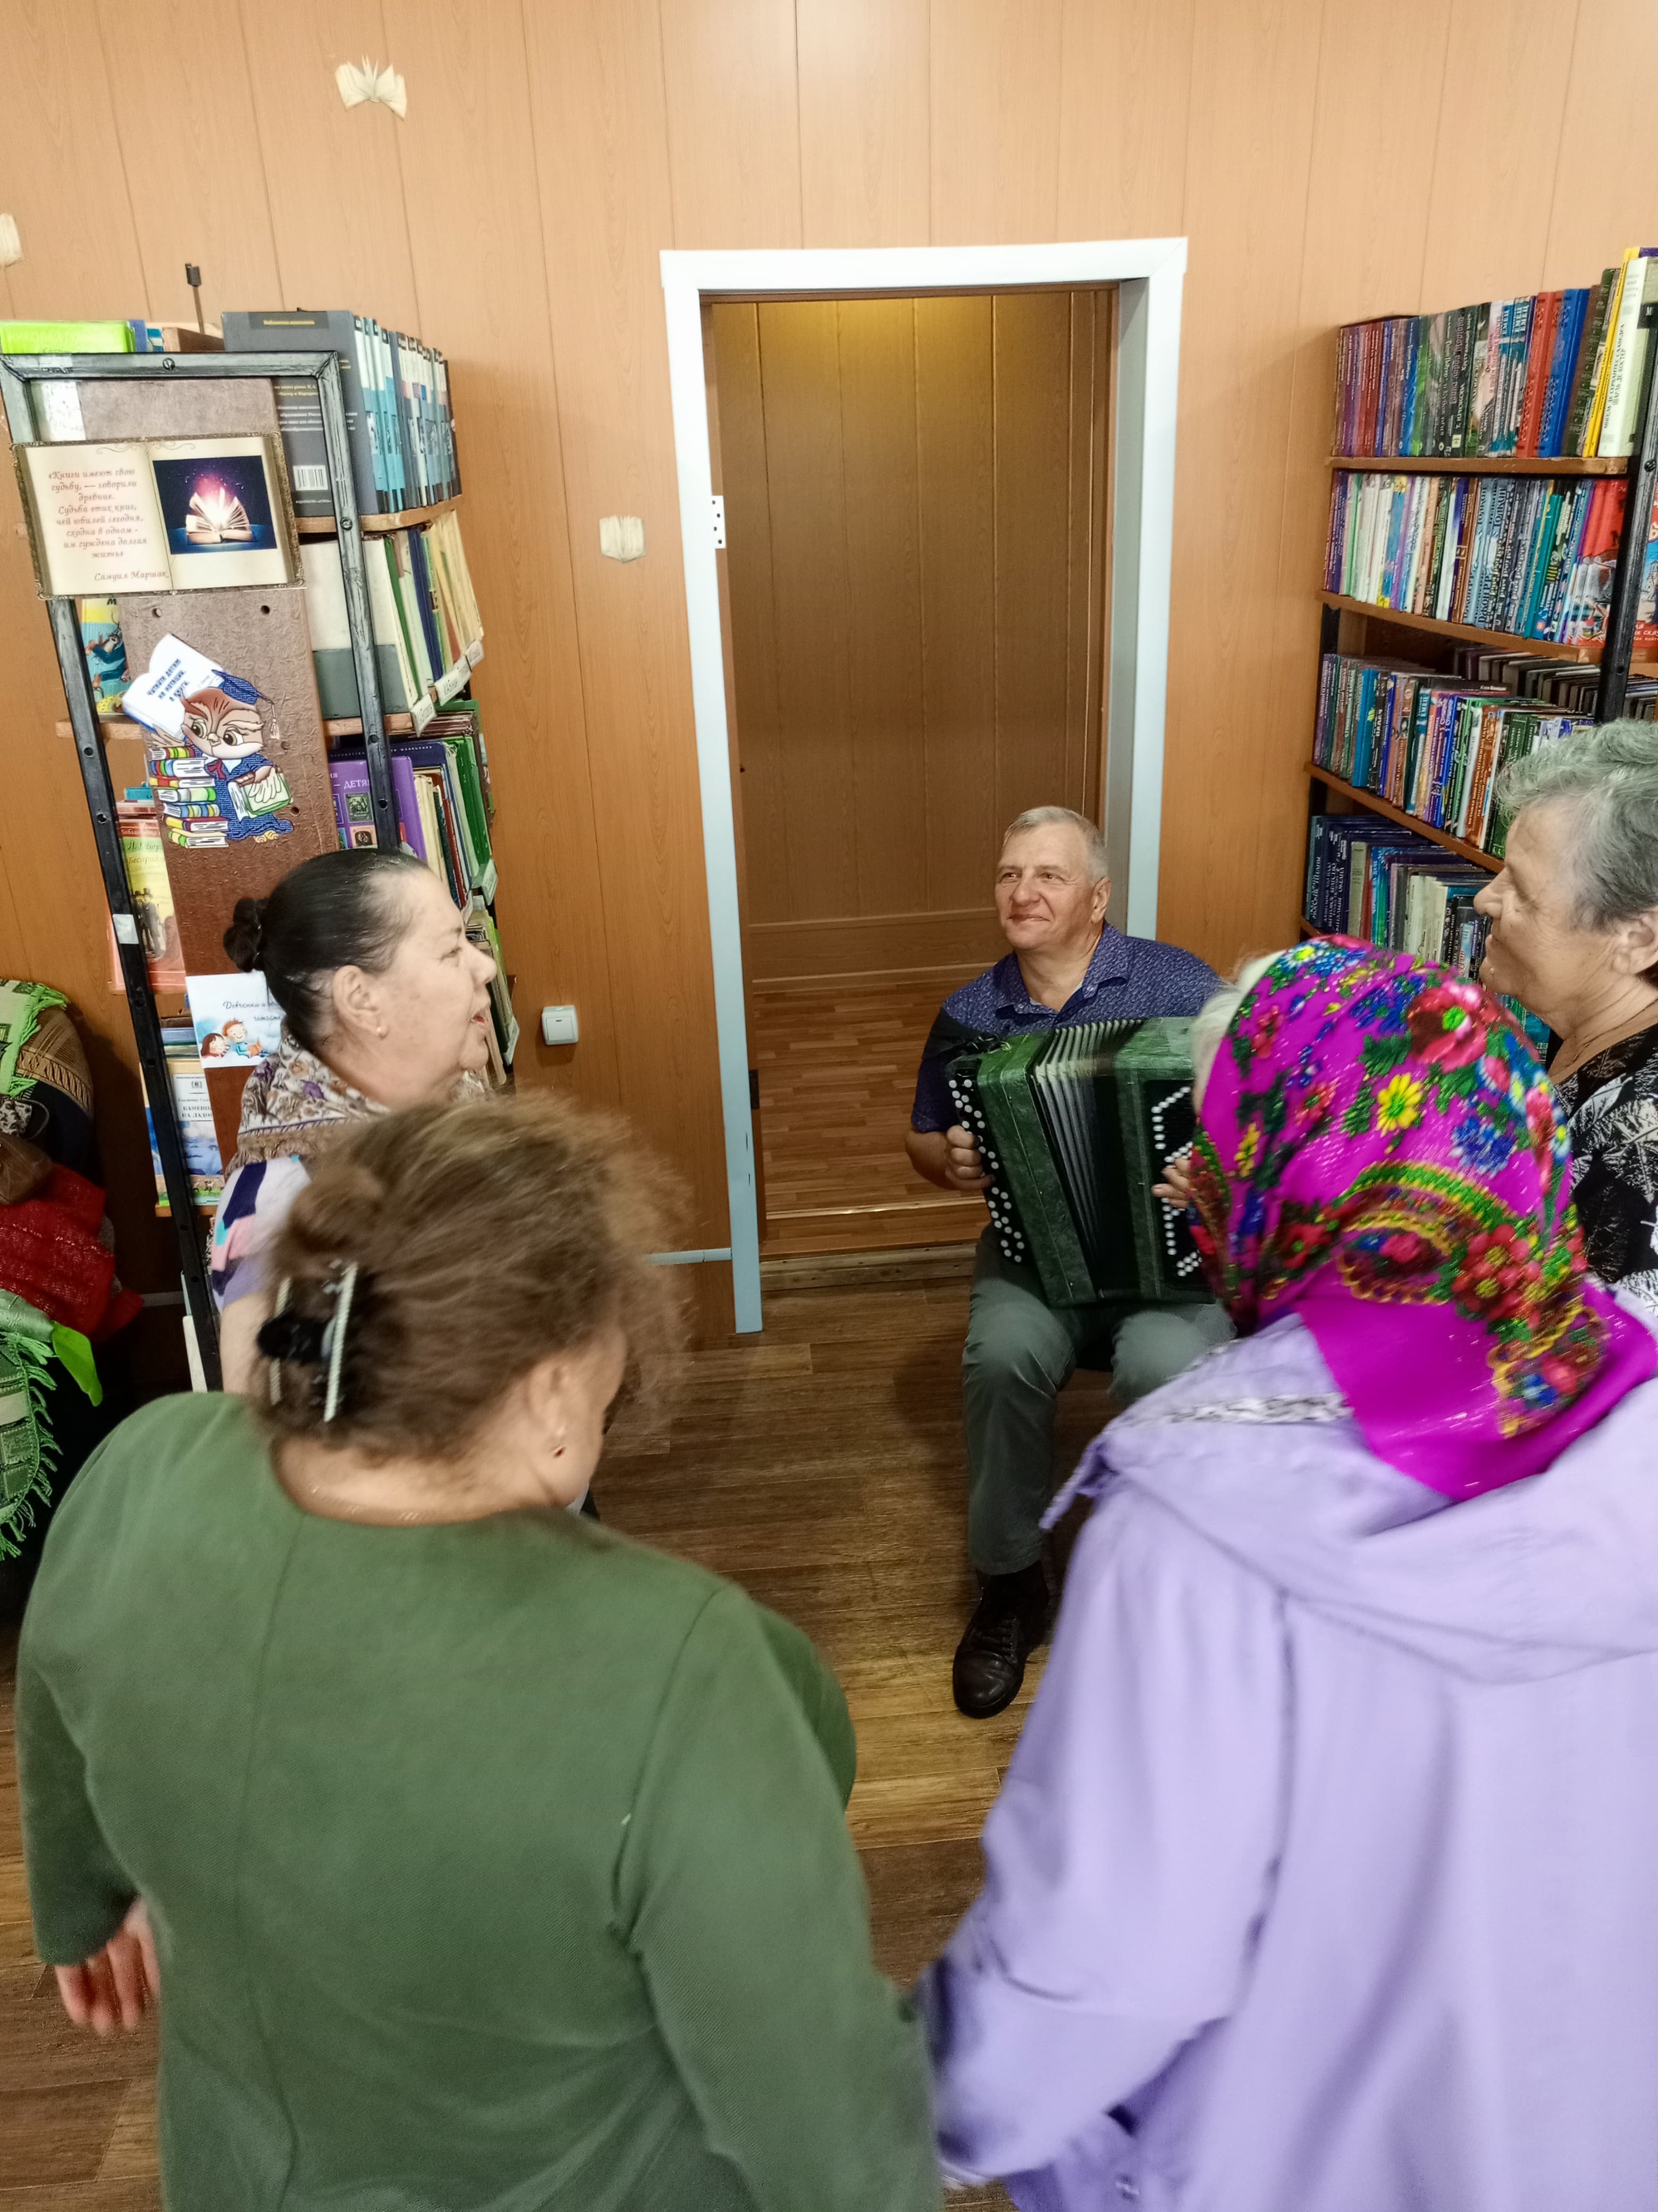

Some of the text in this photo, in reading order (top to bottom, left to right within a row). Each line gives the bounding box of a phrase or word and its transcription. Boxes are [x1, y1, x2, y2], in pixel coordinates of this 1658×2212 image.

[1521, 305, 1530, 331] ЕМЕЦ
[52, 482, 82, 493] судьбу,
[98, 481, 137, 490] говорили
[79, 493, 115, 504] древние.
[58, 505, 88, 516] Судьба
[114, 504, 137, 513] книг,
[1493, 486, 1507, 527] ТОЛКИН
[74, 516, 105, 524] юбилей
[108, 513, 144, 523] сегодня,
[66, 528, 95, 538] сходна
[106, 526, 131, 534] одном
[79, 539, 115, 550] суждена
[118, 537, 147, 546] долгая
[95, 569, 170, 583] Самуил Маршак
